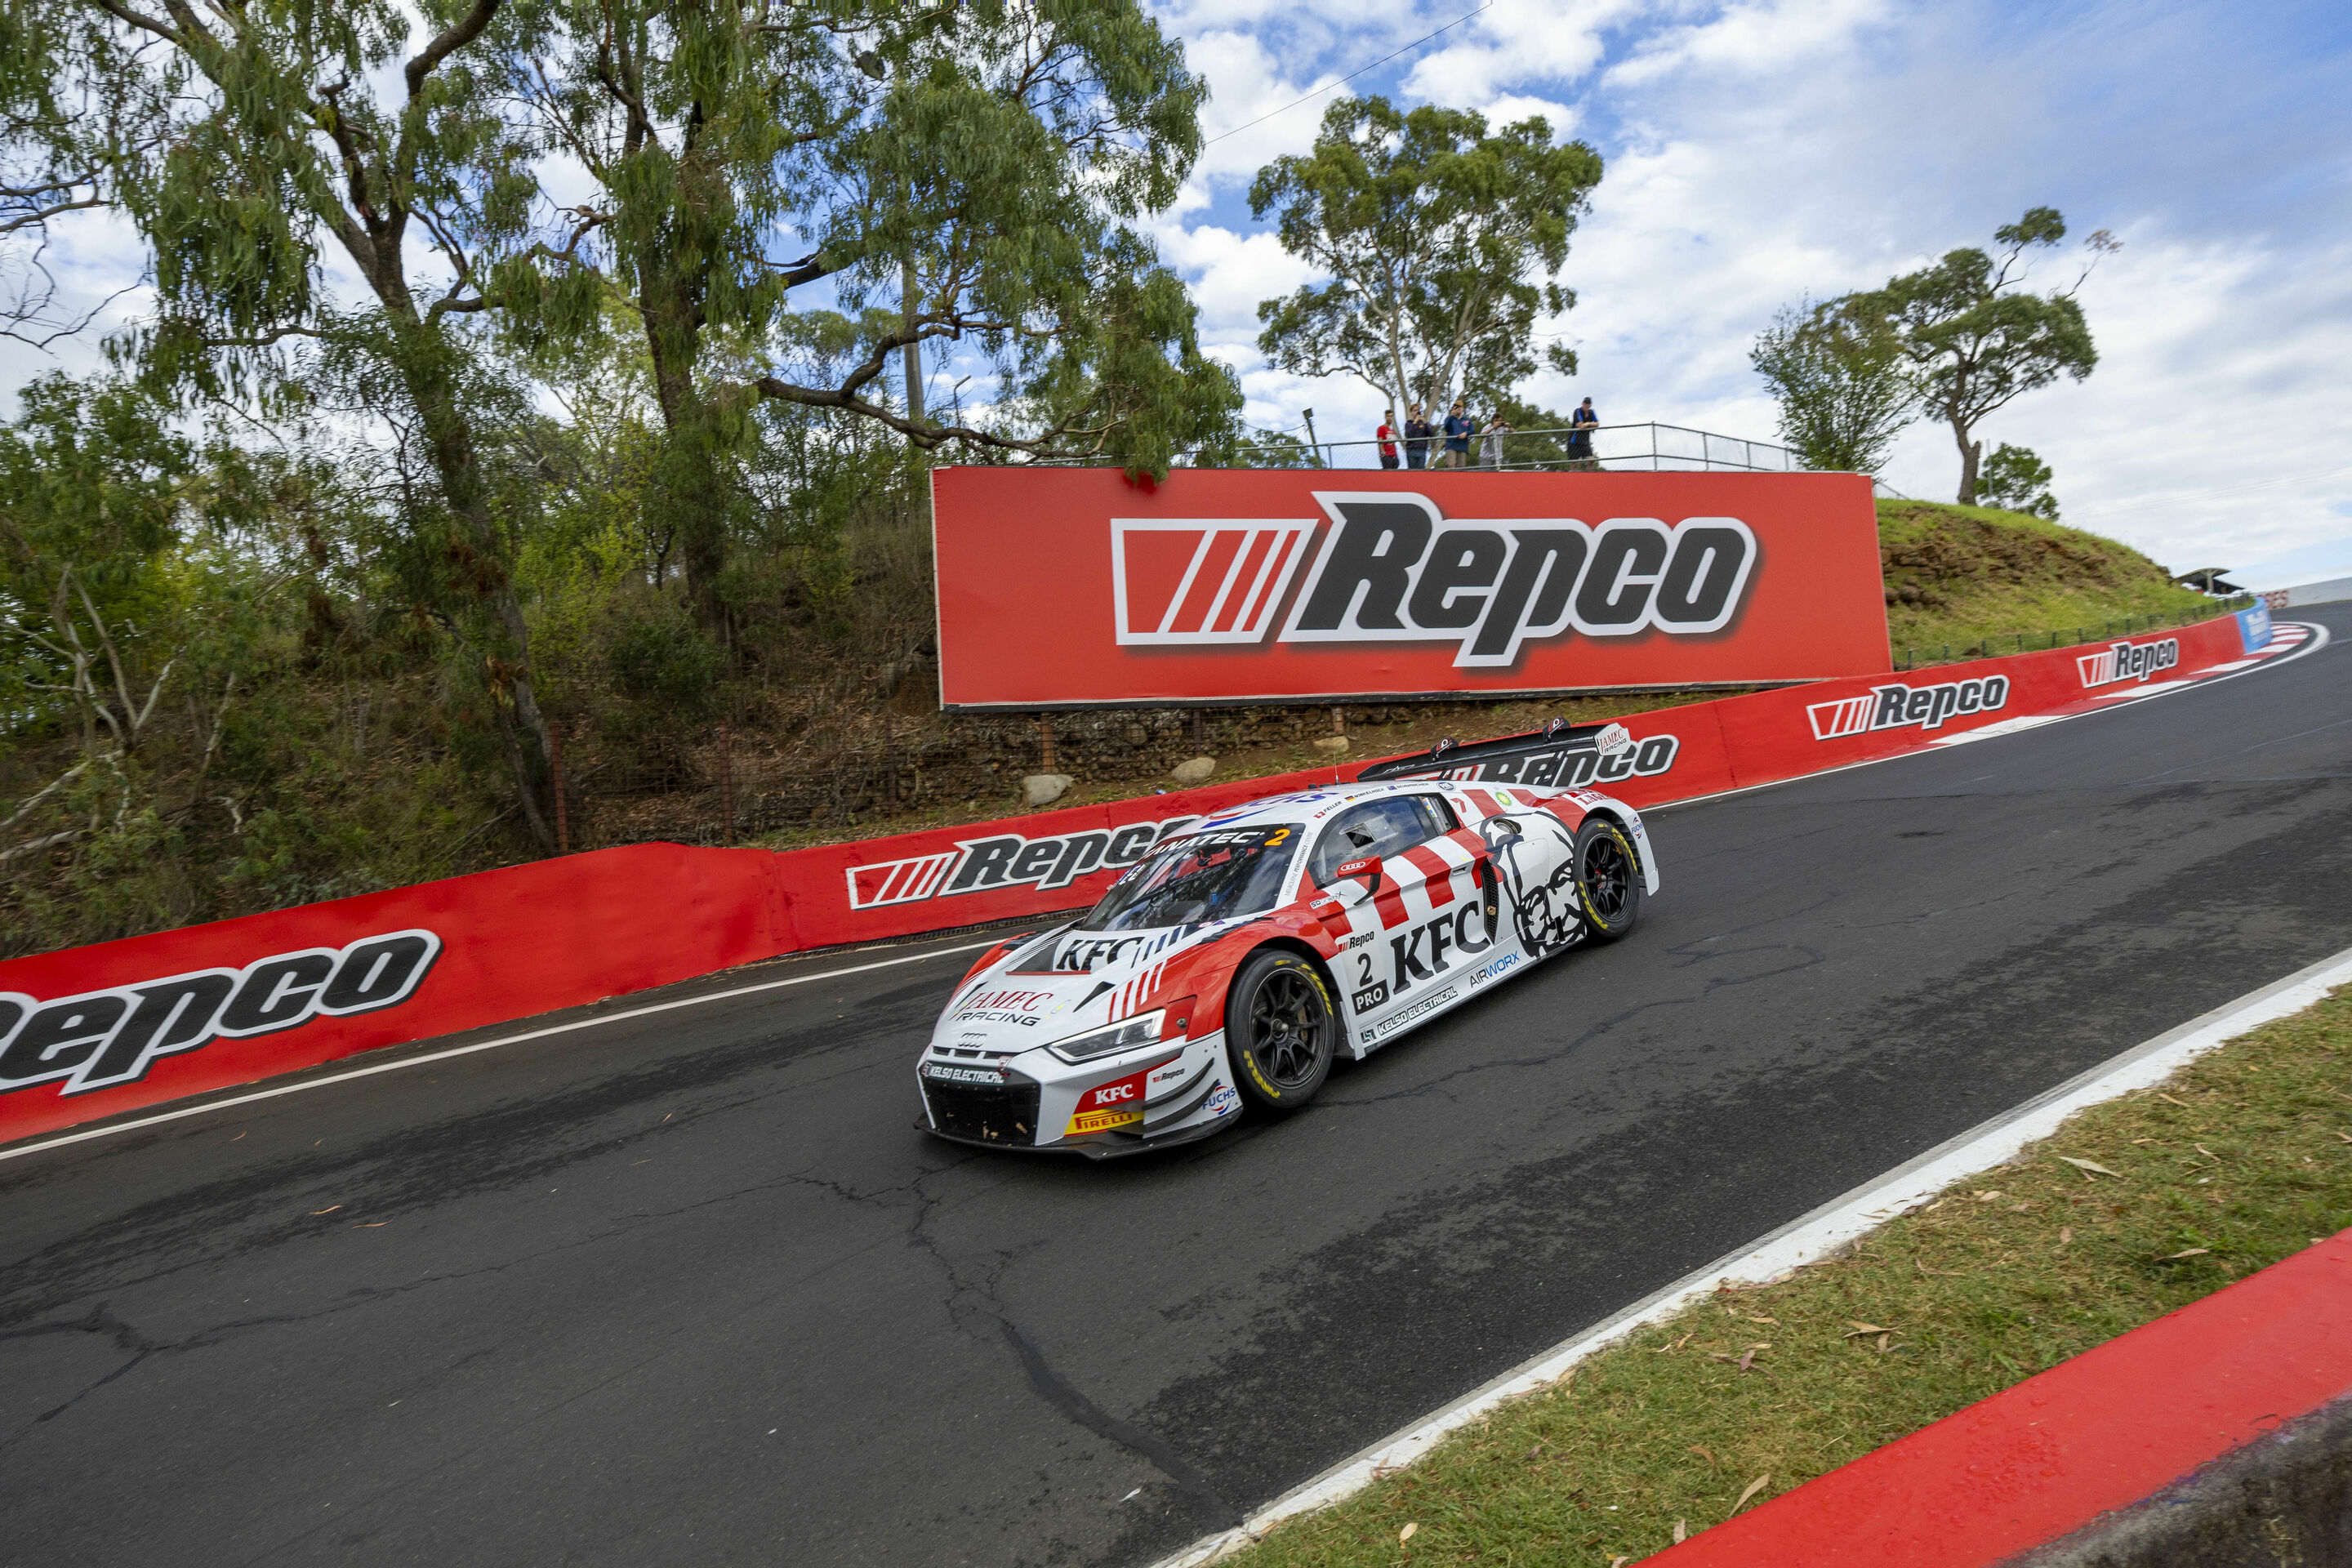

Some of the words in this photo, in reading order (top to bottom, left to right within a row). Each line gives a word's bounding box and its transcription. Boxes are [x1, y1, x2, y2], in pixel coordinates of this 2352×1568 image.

[1293, 500, 1749, 657] Repco
[2115, 639, 2176, 681] Repco
[1873, 677, 2007, 728] Repco
[1598, 728, 1623, 754] JAMEC
[1605, 738, 1627, 753] RACING
[1323, 801, 1342, 813] FELLER
[1264, 828, 1290, 846] 2
[1348, 931, 1374, 950] Repco
[1390, 900, 1491, 996] KFC
[1056, 936, 1145, 971] KFC
[1356, 952, 1374, 987] 2
[1469, 950, 1519, 988] AIRWORX
[950, 991, 1054, 1020] JAMEC
[1356, 987, 1383, 1011] PRO
[956, 1012, 1041, 1027] RACING
[1378, 1010, 1408, 1036] KELSO
[1407, 987, 1458, 1019] ELECTRICAL
[930, 1066, 953, 1079] KELSO
[953, 1068, 1005, 1084] ELECTRICAL
[1160, 1068, 1186, 1081] Repco
[1094, 1084, 1134, 1105] KFC
[1201, 1087, 1236, 1111] FUCHS
[1075, 1111, 1133, 1130] PIRELLI
